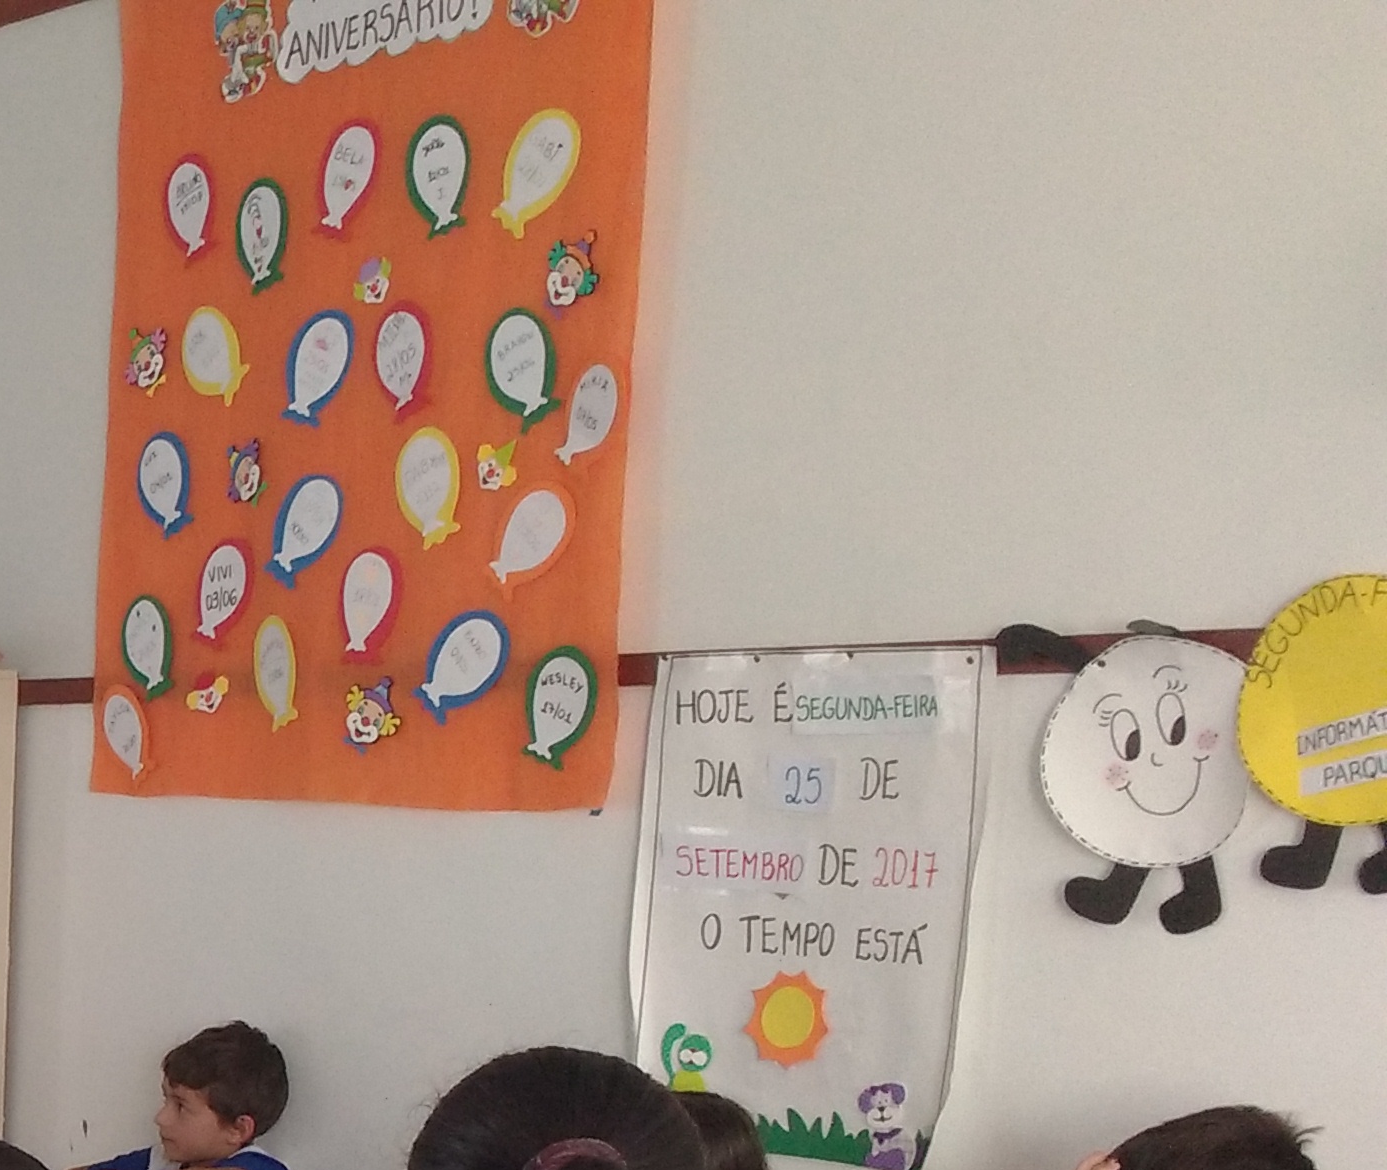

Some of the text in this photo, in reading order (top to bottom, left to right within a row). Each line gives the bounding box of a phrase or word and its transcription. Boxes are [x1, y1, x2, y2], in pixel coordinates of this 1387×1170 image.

[207, 563, 233, 584] VIVI
[205, 586, 238, 612] 03/06
[540, 670, 586, 695] WESLEY
[675, 681, 939, 725] HOJE É SEGUNDA-FEIRA
[693, 756, 900, 805] DIA 25 DE
[675, 843, 940, 889] SETEMBRO DE 2017
[700, 912, 929, 965] O TEMPO ESTÁ
